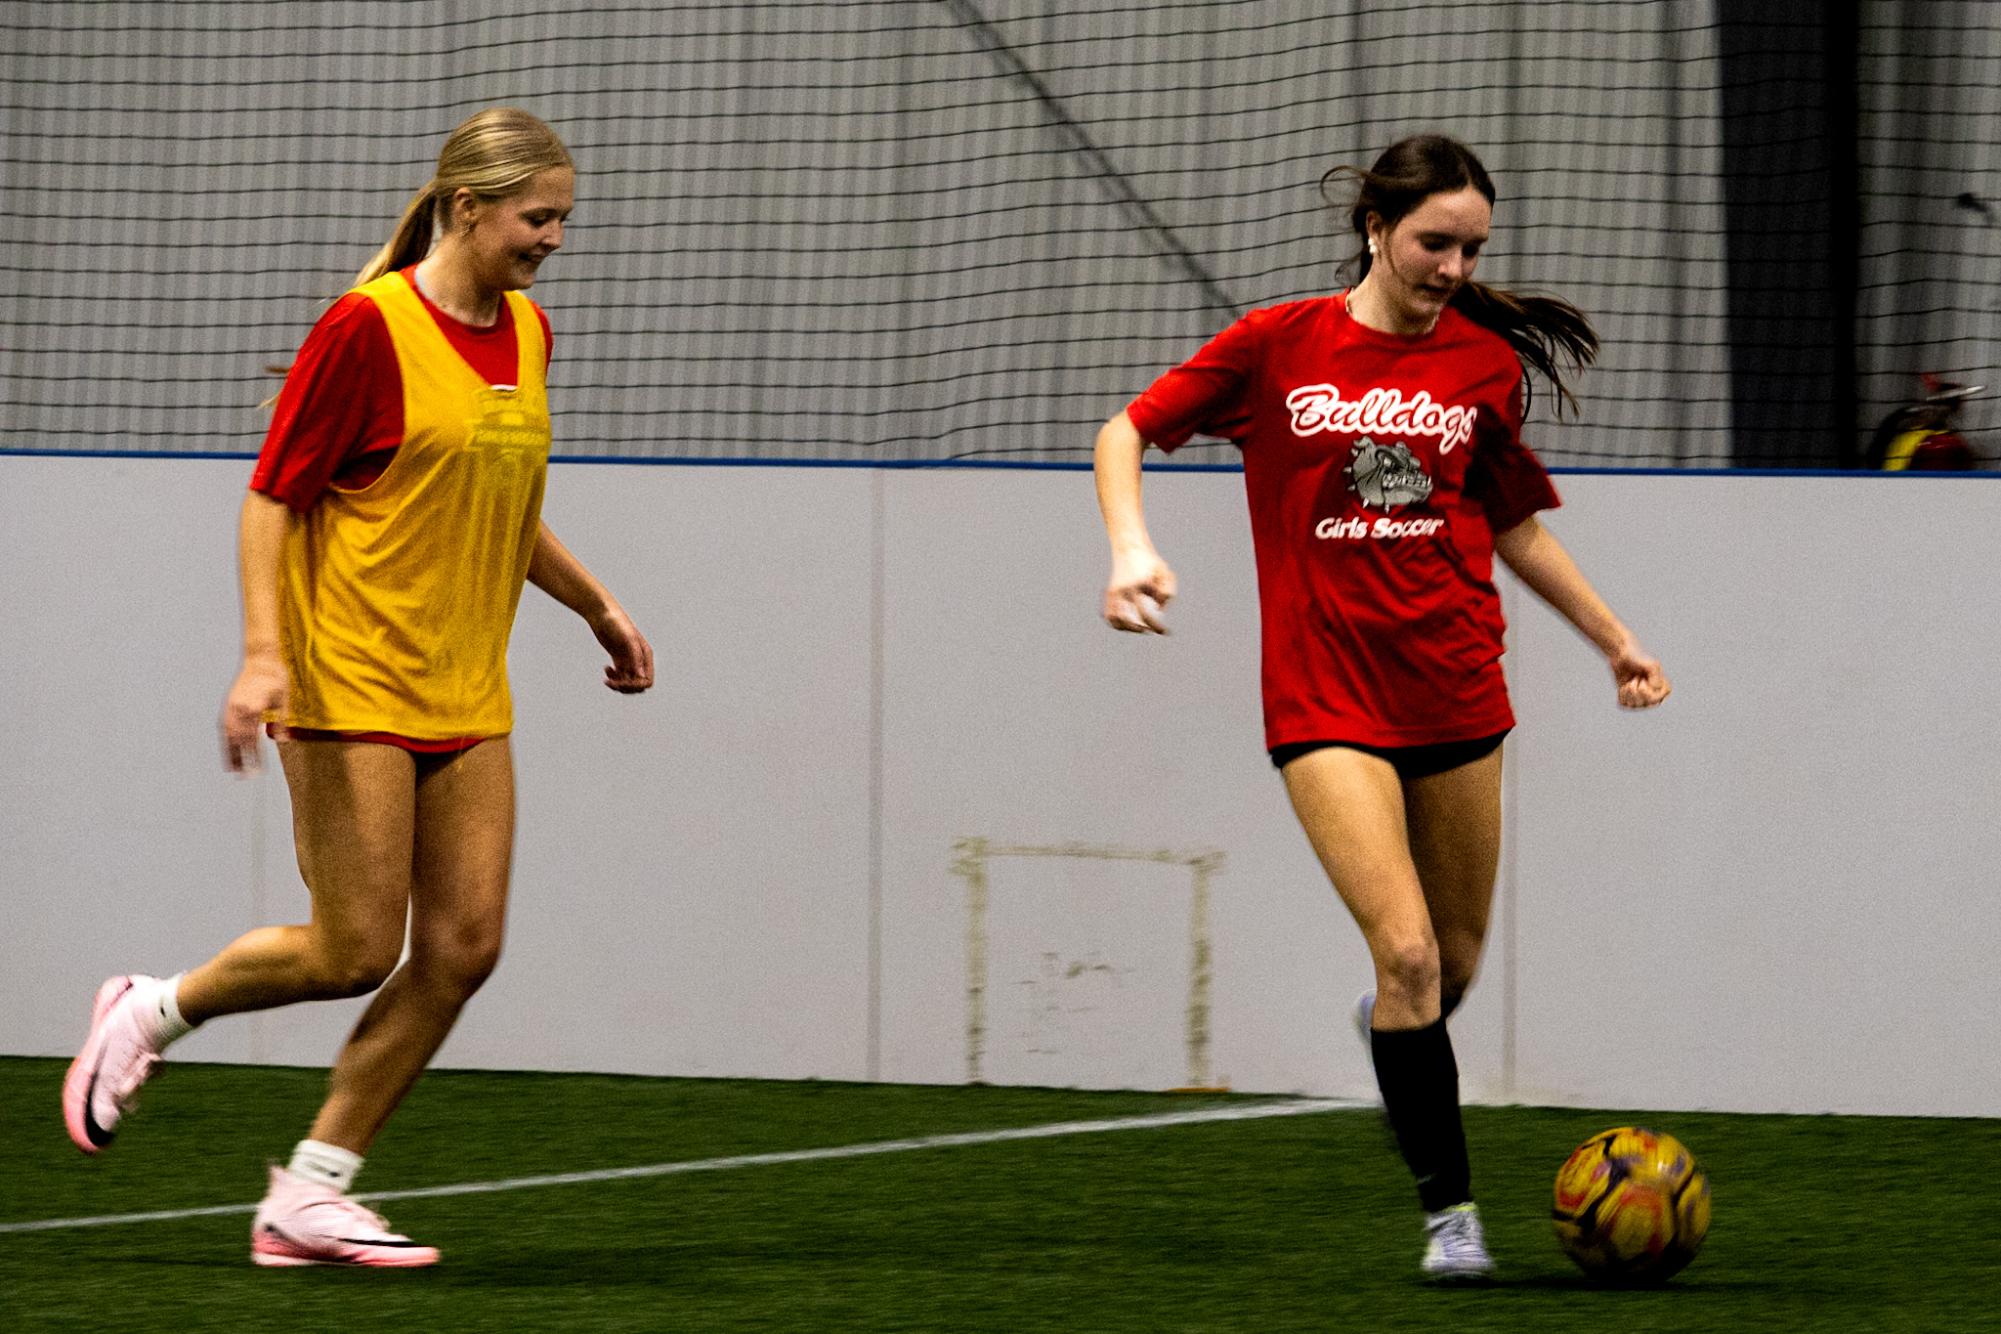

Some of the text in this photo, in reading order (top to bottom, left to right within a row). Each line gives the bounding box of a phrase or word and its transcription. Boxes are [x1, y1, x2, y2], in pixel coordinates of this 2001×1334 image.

[1286, 383, 1478, 455] Bulldogs
[1315, 516, 1444, 539] Girls Soccer
